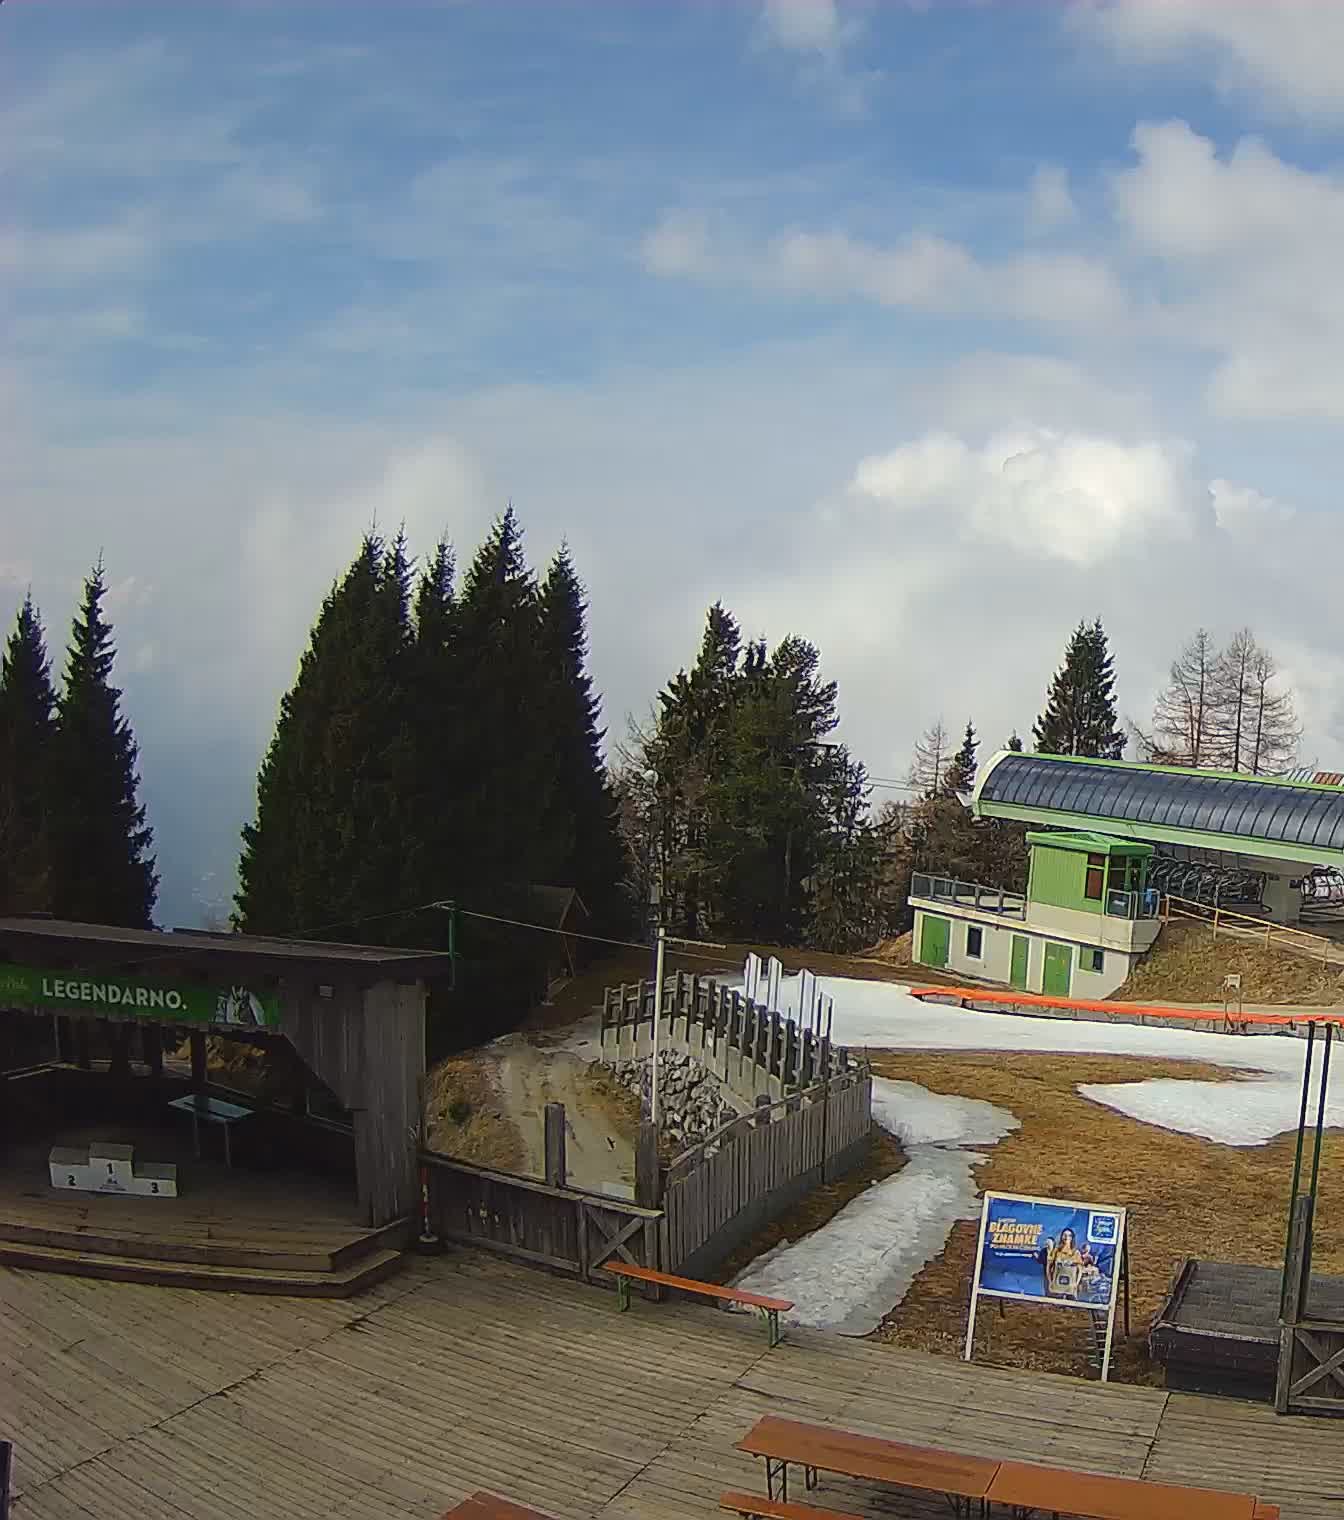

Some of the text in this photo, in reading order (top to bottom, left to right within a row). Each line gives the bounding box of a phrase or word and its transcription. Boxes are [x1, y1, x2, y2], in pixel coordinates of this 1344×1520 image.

[106, 1161, 114, 1175] 1
[66, 1174, 77, 1187] 2
[151, 1181, 160, 1194] 3
[992, 1232, 1039, 1246] ZNAMKE
